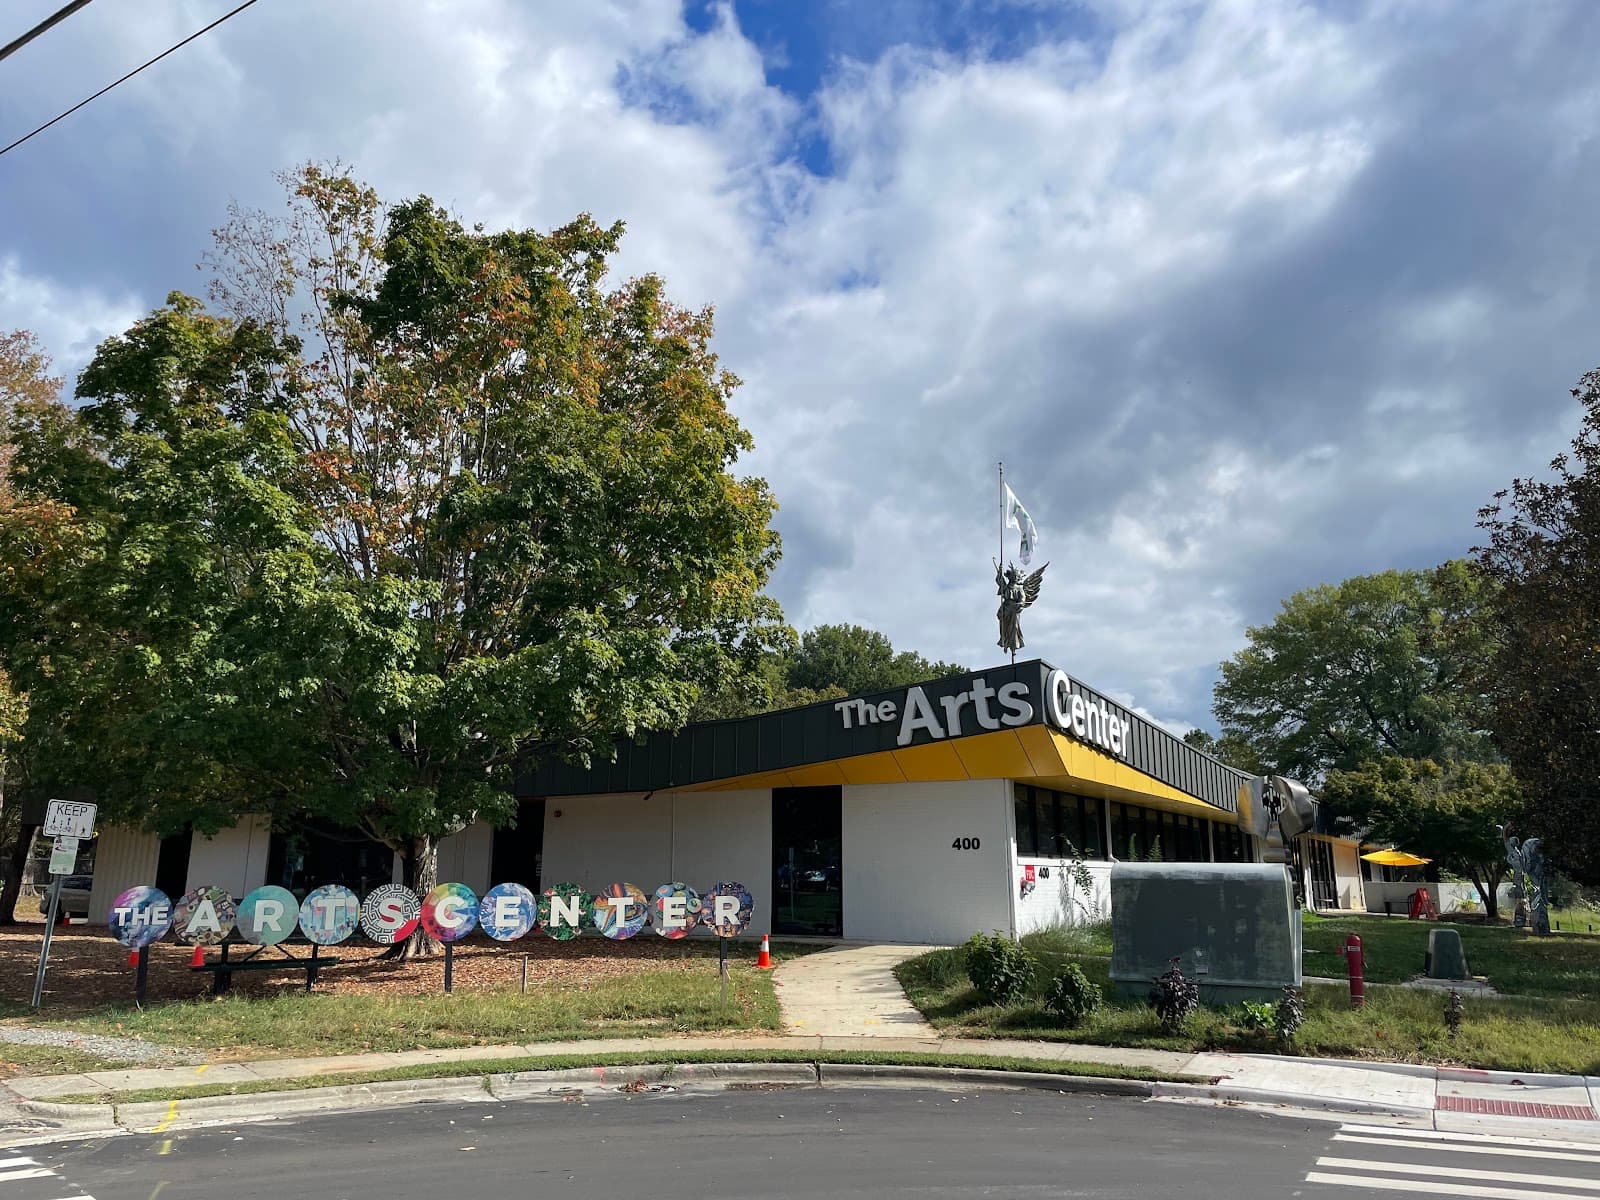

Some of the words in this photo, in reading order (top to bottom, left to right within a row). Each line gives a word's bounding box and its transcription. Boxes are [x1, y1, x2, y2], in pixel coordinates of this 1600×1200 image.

[834, 698, 898, 729] The
[896, 678, 1034, 746] Arts
[1046, 669, 1130, 758] Center
[56, 804, 88, 817] KEEP
[952, 837, 981, 850] 400
[1038, 866, 1050, 880] 400
[114, 906, 169, 927] THE
